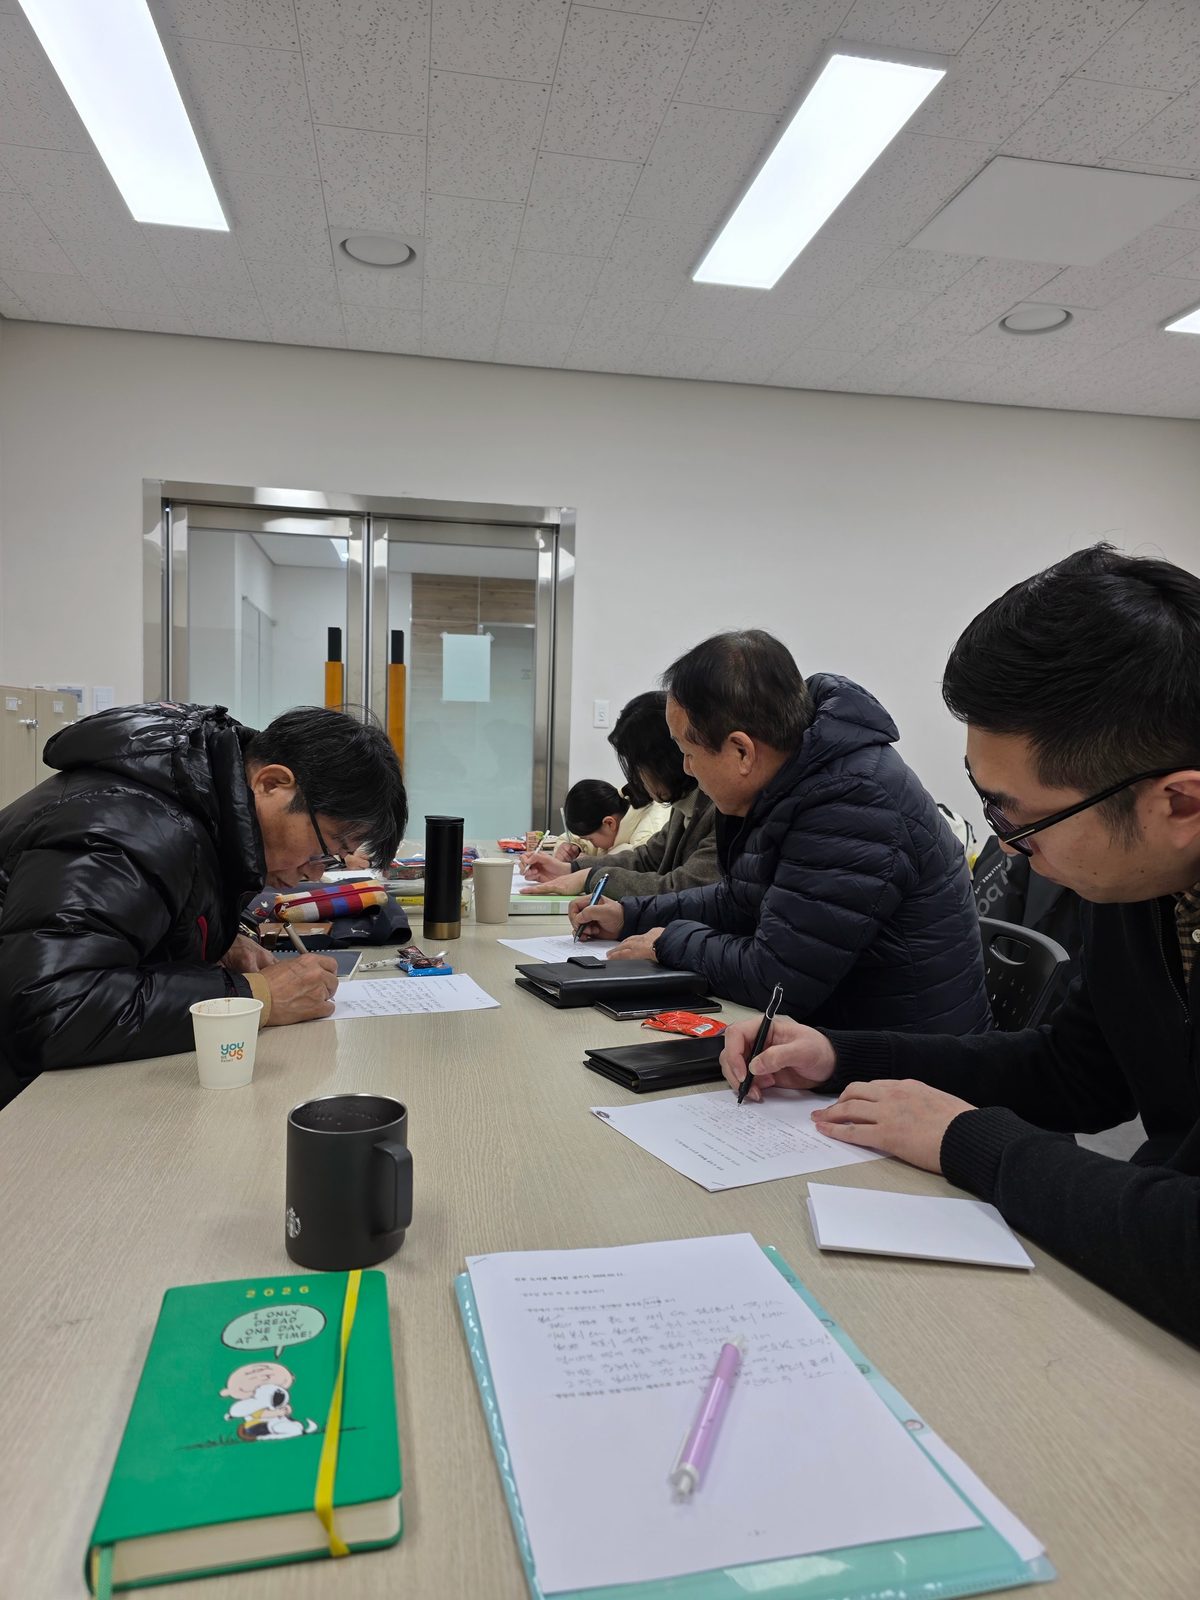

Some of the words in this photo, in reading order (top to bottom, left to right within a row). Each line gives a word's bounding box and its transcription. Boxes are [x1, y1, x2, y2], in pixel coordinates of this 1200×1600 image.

[221, 1041, 245, 1056] you
[229, 1048, 243, 1060] us
[246, 1286, 309, 1299] 2026
[266, 1309, 300, 1319] ONLY
[254, 1317, 297, 1328] DREAD
[245, 1327, 271, 1336] ONE
[278, 1323, 304, 1333] DAY
[277, 1331, 312, 1340] TIME!
